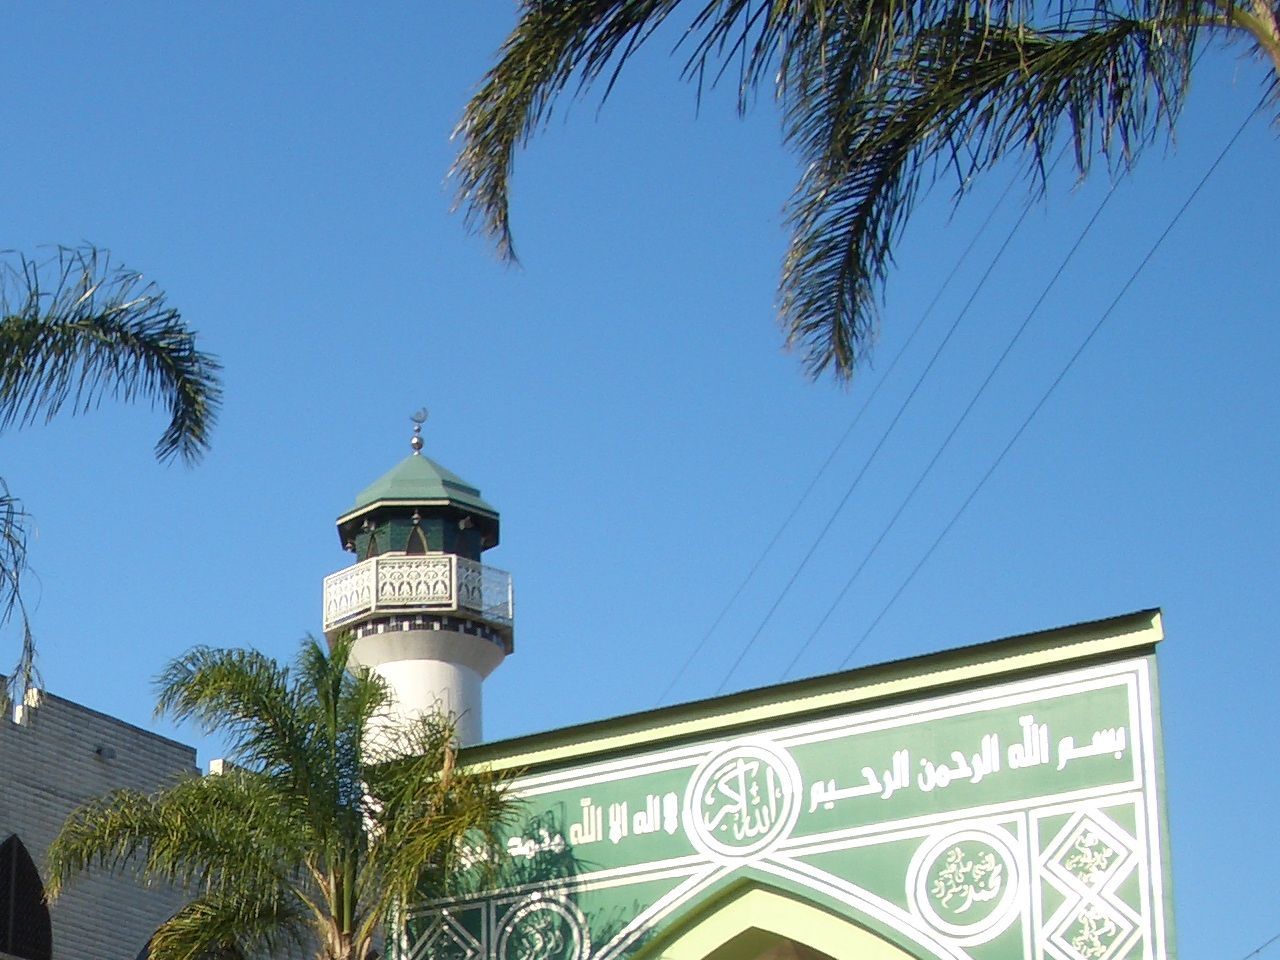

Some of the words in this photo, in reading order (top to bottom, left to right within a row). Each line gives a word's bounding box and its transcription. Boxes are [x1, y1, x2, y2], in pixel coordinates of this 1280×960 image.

[917, 733, 1000, 792] الرحمن
[1007, 714, 1049, 769] الله
[1057, 726, 1126, 771] بسم
[808, 749, 910, 813] الرحيم
[570, 797, 602, 845] الله
